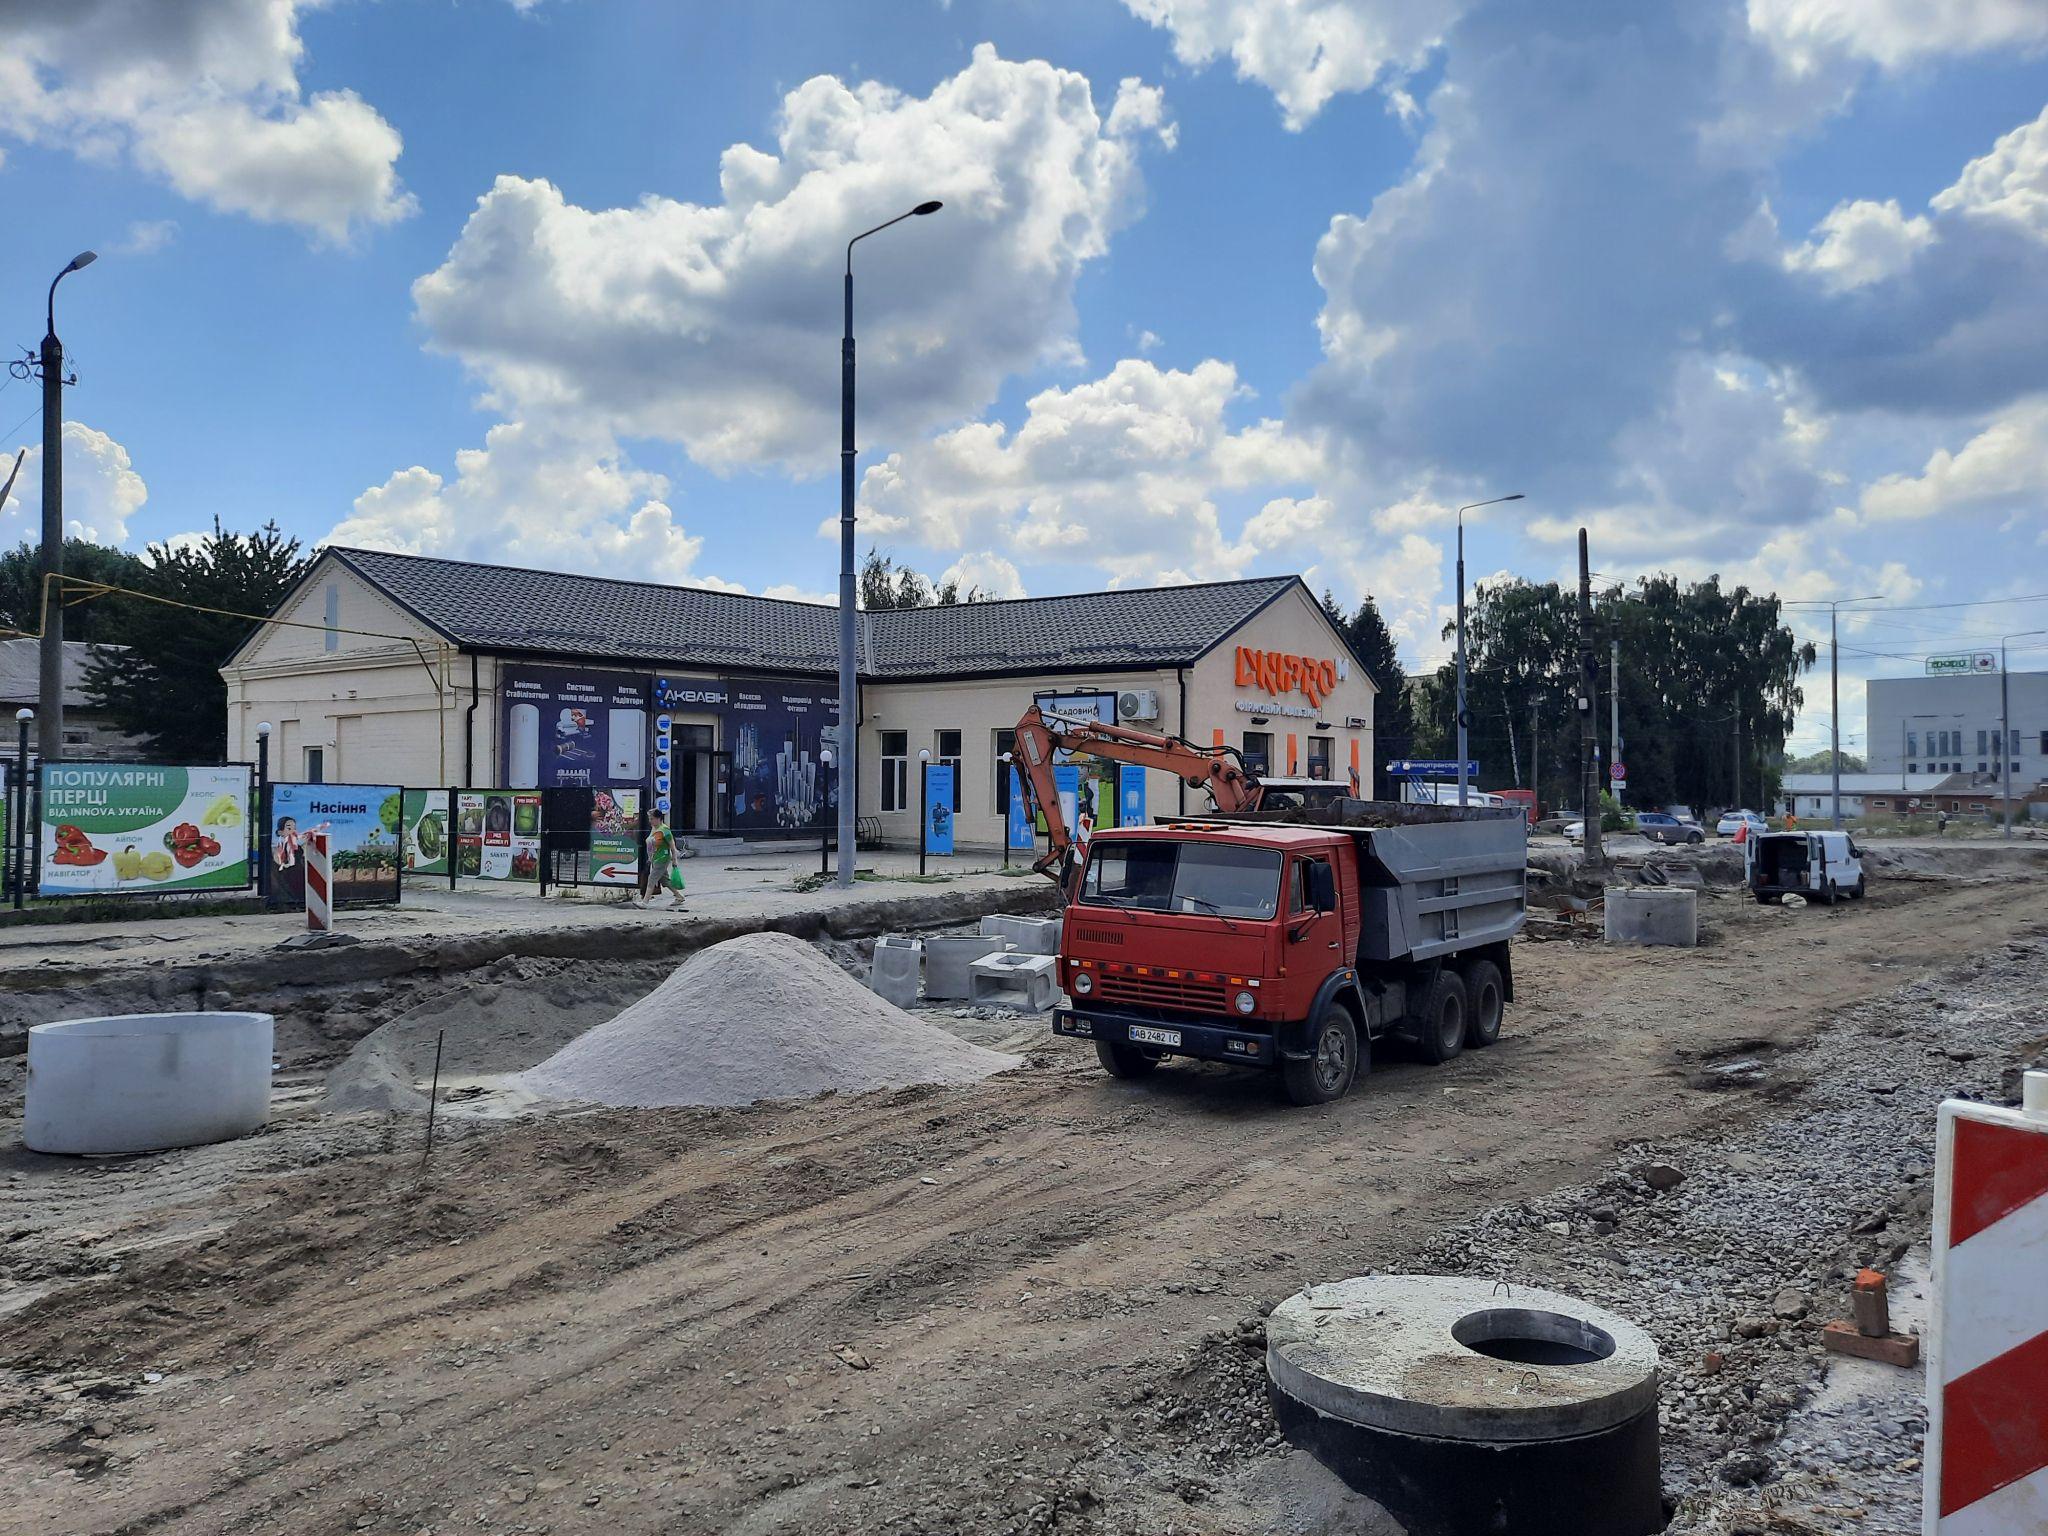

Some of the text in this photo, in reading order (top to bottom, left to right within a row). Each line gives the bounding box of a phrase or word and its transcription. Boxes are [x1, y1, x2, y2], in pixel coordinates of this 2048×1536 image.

[505, 690, 549, 700] Стабілізатори
[663, 689, 729, 704] АКВАВІН
[1058, 706, 1093, 716] САДОВИЙ
[50, 771, 164, 786] ПОПУЛЯРНІ
[49, 789, 107, 806] ПЕРЦІ
[48, 806, 164, 817] ВІД INNOVA УКРАЇНА
[310, 801, 367, 814] Насіння
[47, 870, 91, 878] НАВІГАТОР
[1147, 1031, 1166, 1042] 2482
